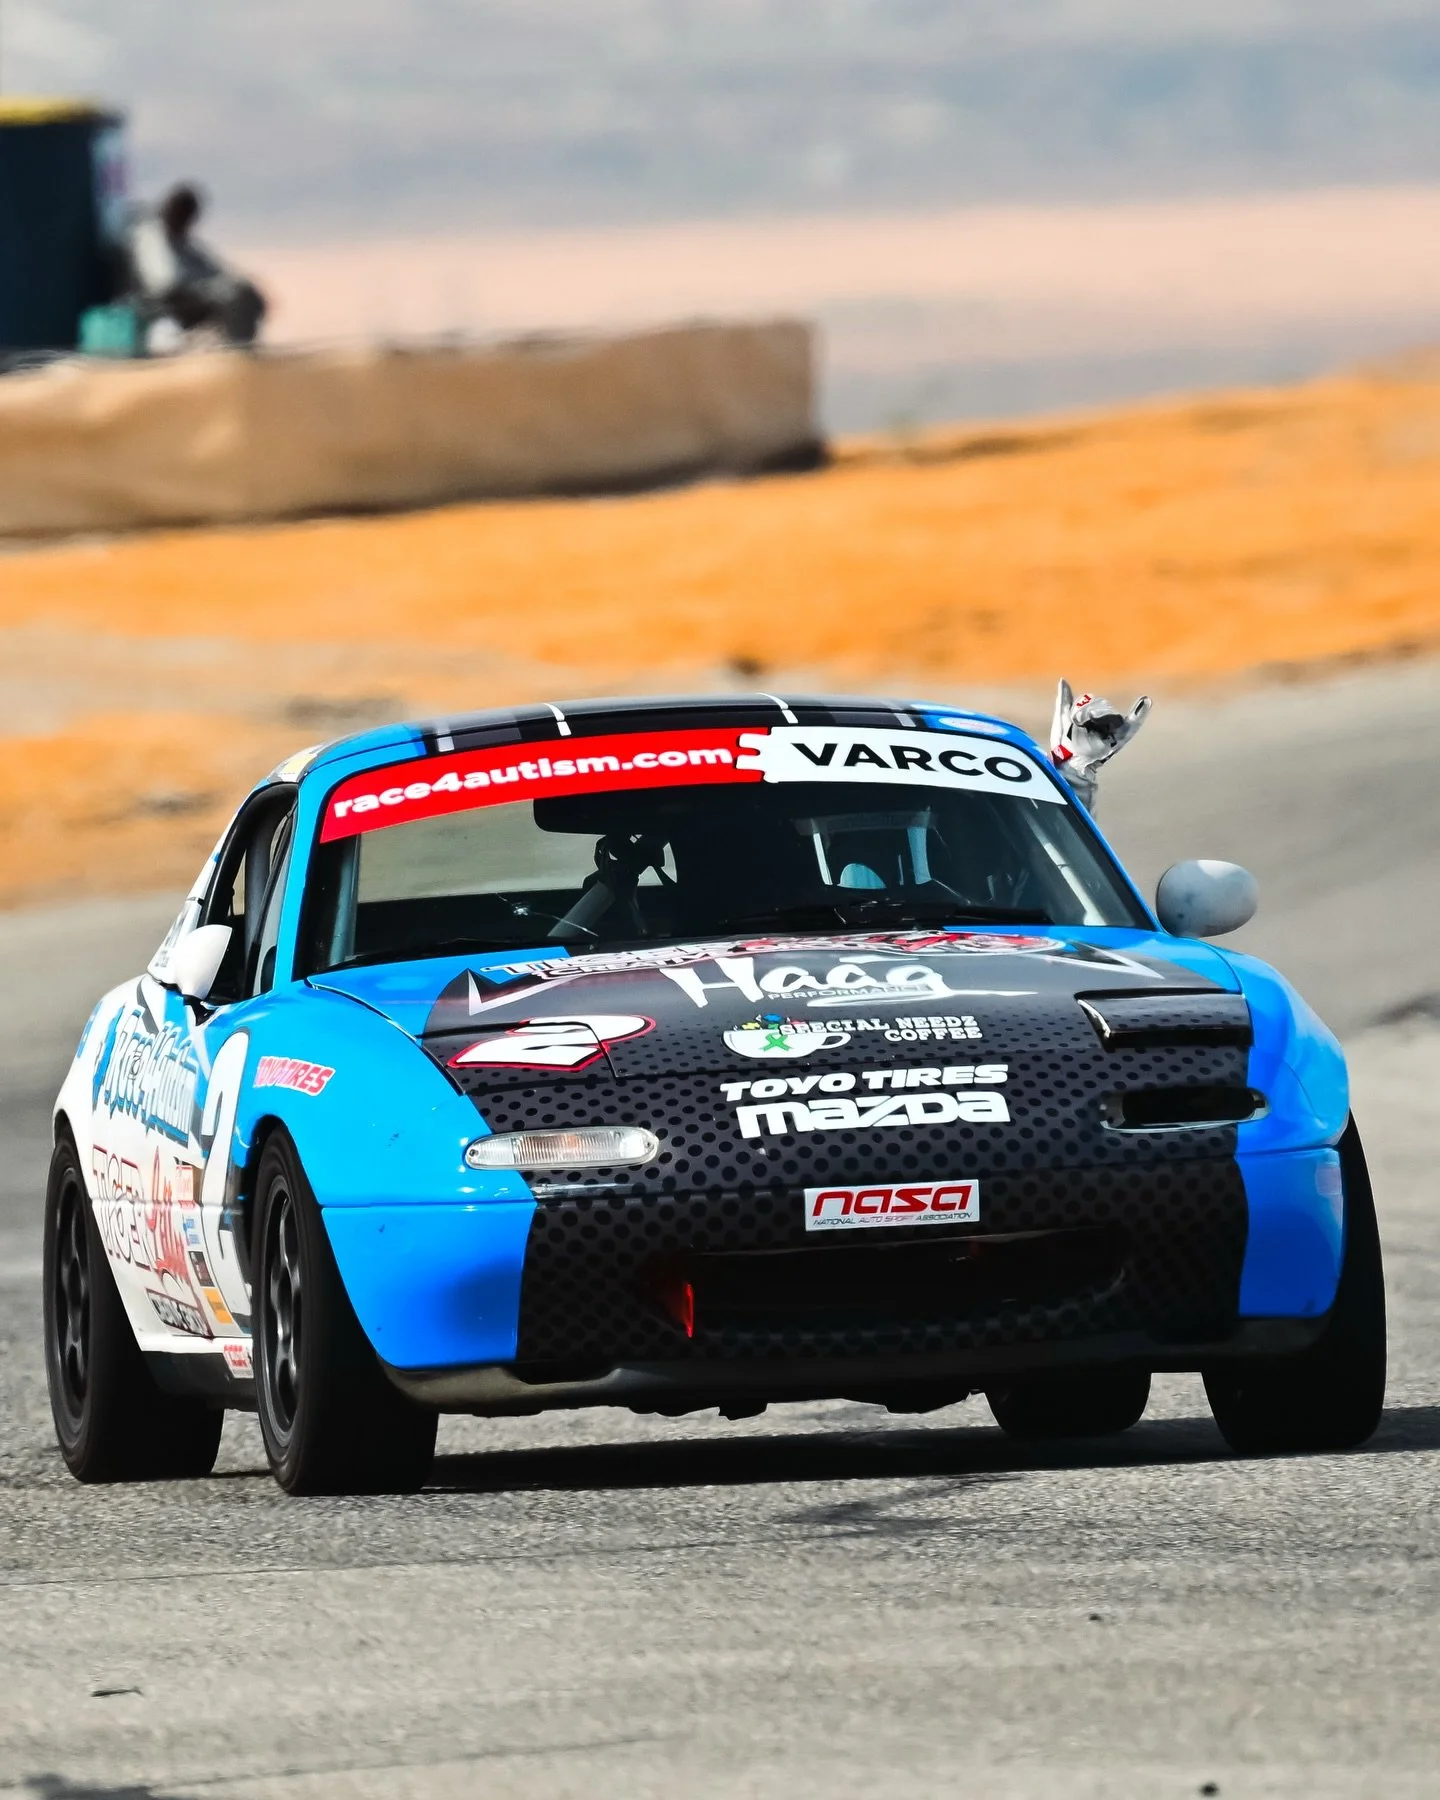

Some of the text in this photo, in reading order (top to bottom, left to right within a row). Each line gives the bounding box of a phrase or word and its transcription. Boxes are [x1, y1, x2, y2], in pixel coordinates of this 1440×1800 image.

[790, 743, 1033, 783] VARCO
[333, 746, 733, 819] race4autism.com
[449, 1014, 656, 1071] 2
[779, 1015, 978, 1036] SPECIAL NEEDZ
[883, 1026, 983, 1042] COFFEE
[719, 1063, 1009, 1102] TOYO TIRES
[812, 1185, 973, 1217] nasa
[813, 1211, 973, 1226] NATIONAL AUTO SPORT ASSOCIATION
